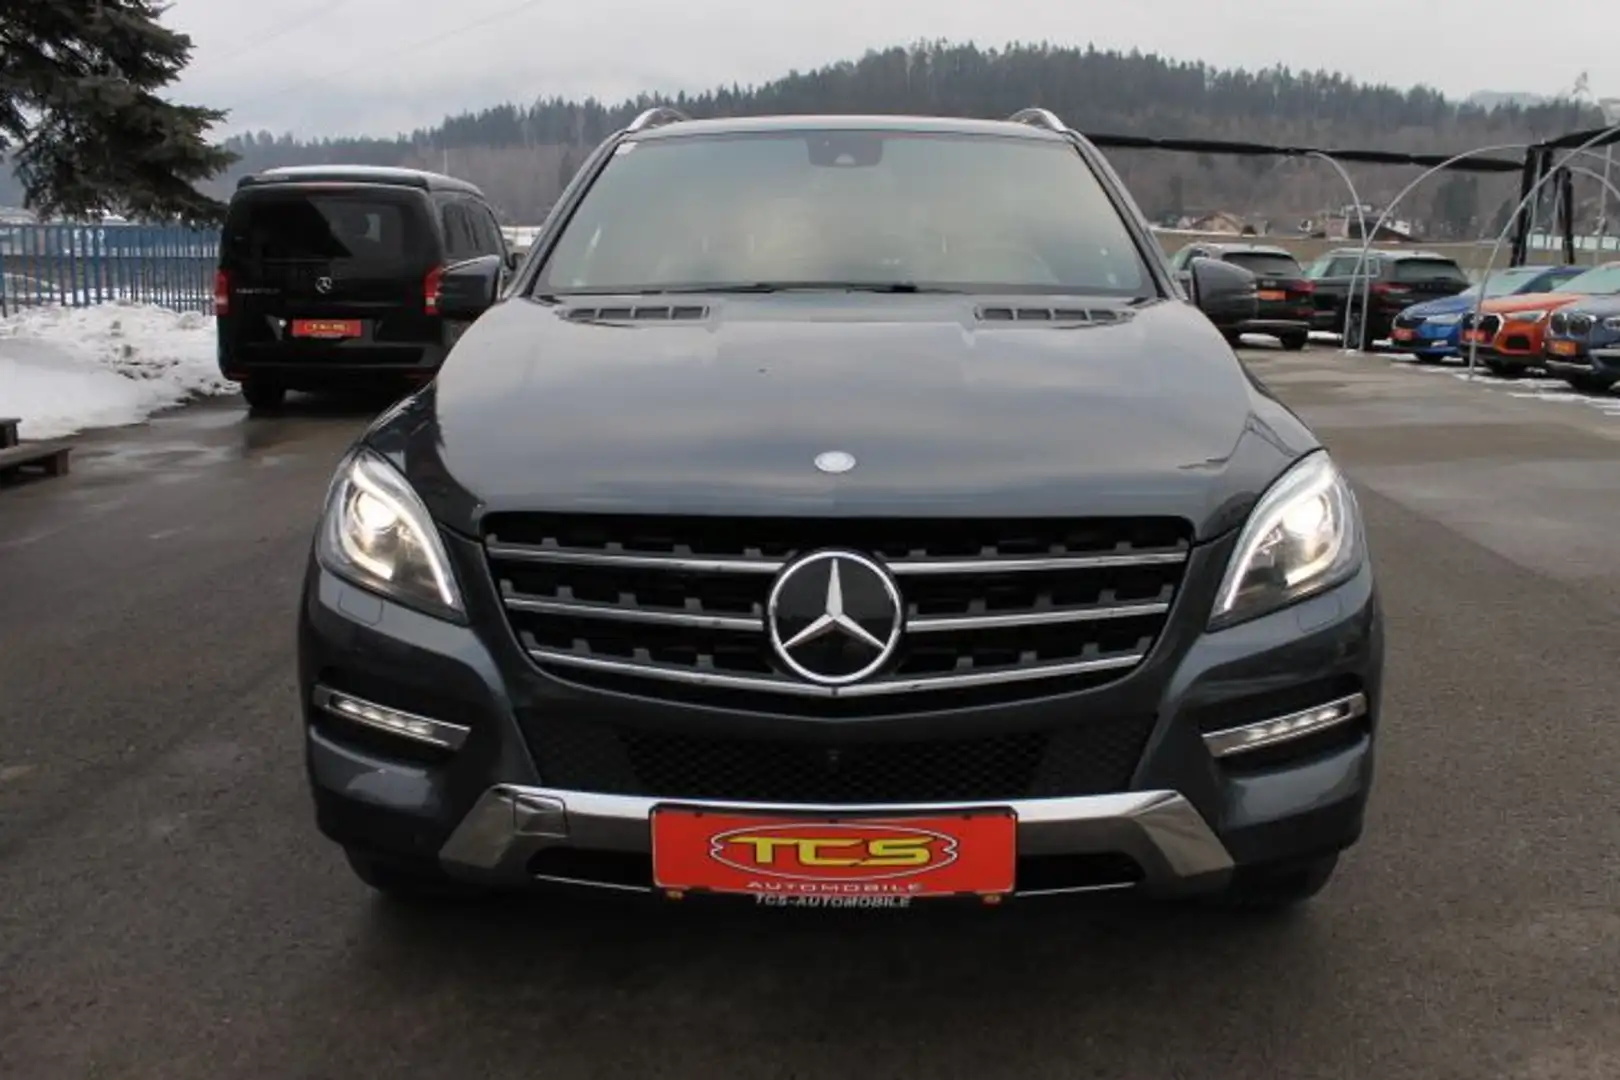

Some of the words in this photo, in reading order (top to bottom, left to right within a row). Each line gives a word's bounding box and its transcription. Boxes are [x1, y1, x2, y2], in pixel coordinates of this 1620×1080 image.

[726, 836, 936, 867] TCS
[746, 881, 924, 892] AUTOMOBILE
[755, 893, 912, 908] TCS-AUTOMOBILE
